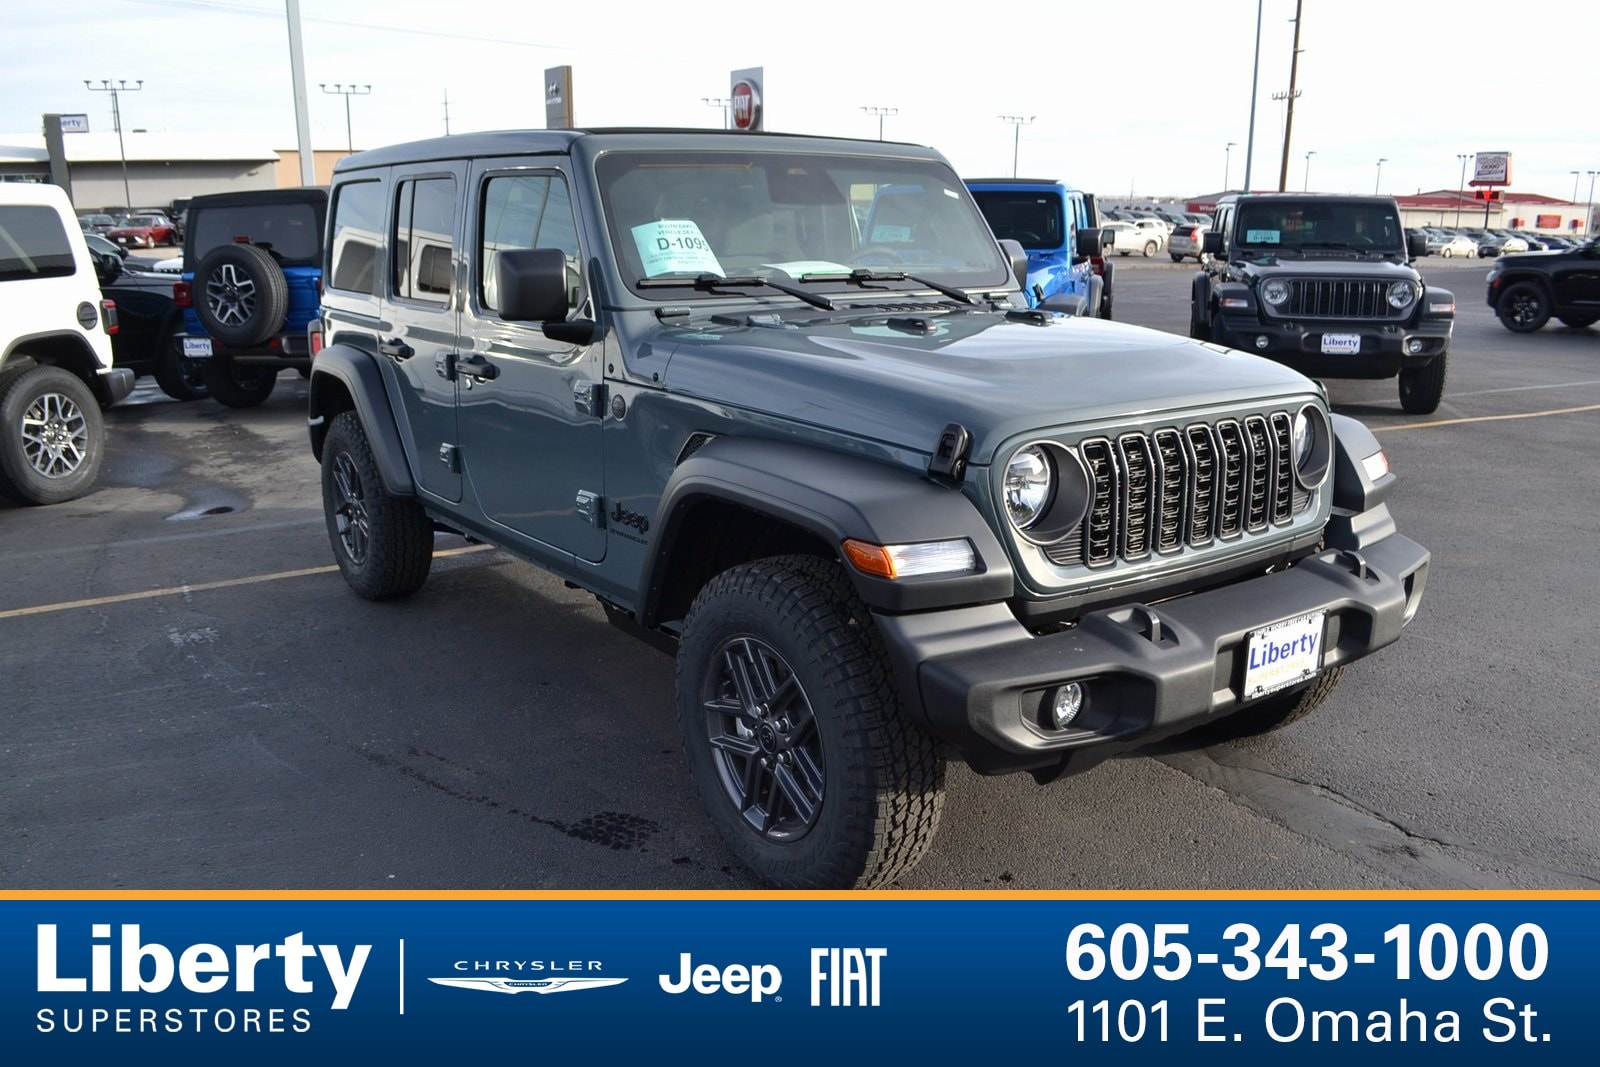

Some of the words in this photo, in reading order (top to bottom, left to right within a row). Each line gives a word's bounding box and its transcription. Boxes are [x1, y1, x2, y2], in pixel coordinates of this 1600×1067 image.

[1323, 337, 1358, 348] Liberty
[611, 502, 649, 535] Jeep
[1249, 632, 1318, 670] Liberty
